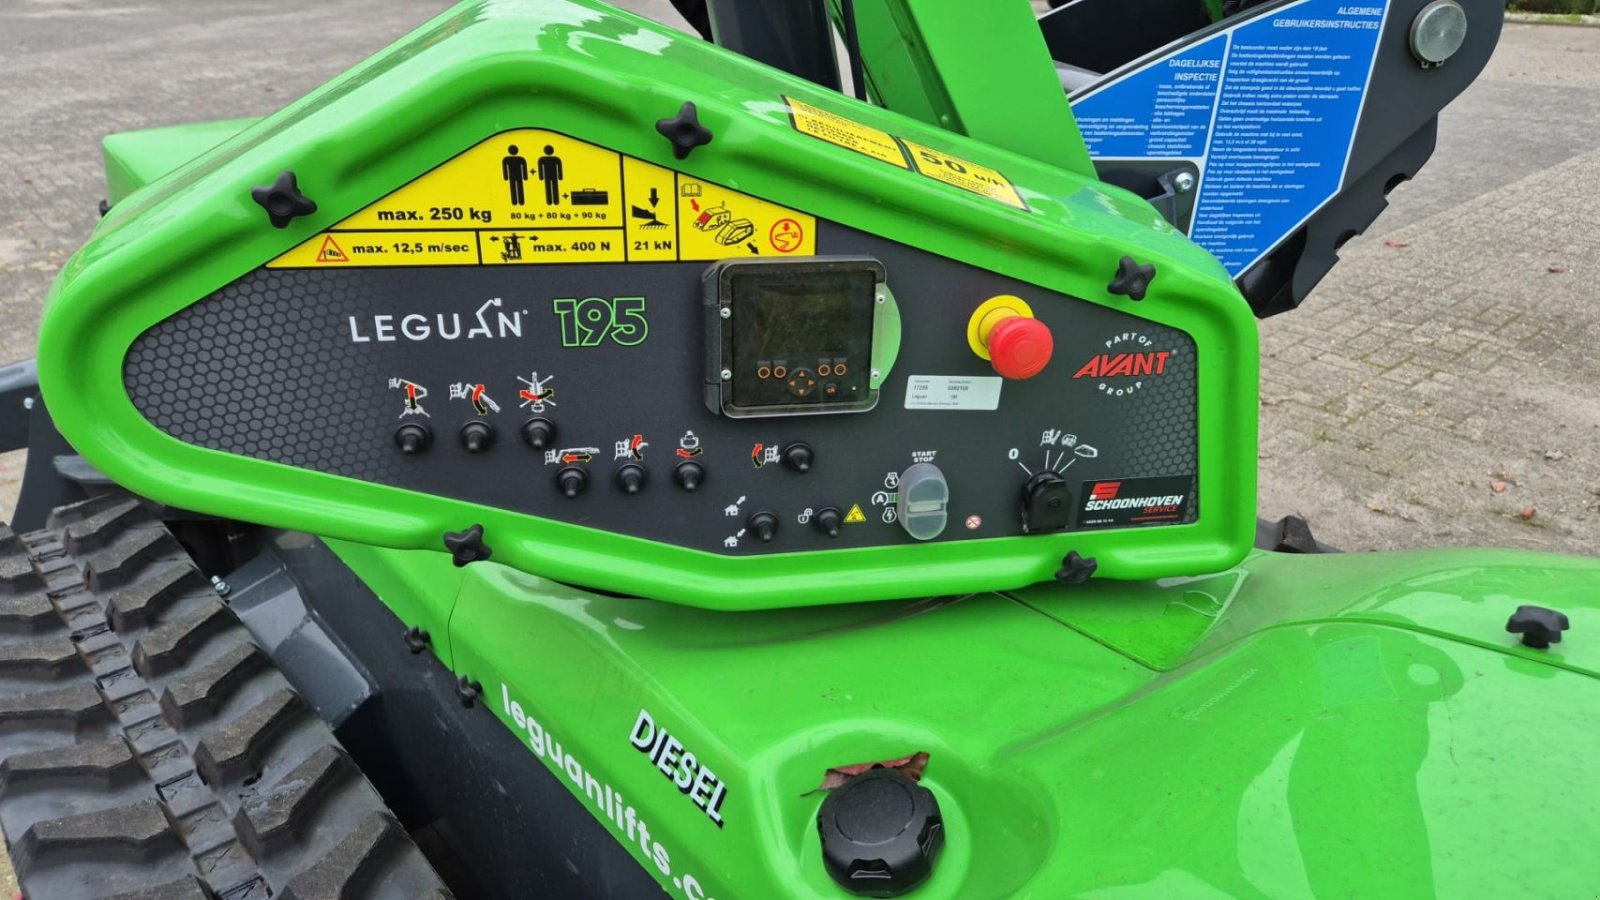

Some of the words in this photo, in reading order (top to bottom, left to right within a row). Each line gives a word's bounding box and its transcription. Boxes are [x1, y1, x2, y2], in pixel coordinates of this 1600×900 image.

[1337, 7, 1382, 16] ALGEMENE
[1273, 19, 1379, 29] GEBRUIKERSINSTRUCTIES
[1169, 60, 1220, 68] DAGELIJKSE
[1174, 73, 1218, 81] INSPECTIE
[920, 150, 967, 174] 50
[378, 209, 424, 222] max.
[429, 208, 464, 221] 250
[469, 207, 492, 223] kg
[510, 212, 520, 220] 80
[522, 211, 536, 221] kg
[546, 212, 557, 220] 80
[558, 211, 572, 221] kg
[582, 211, 593, 219] 90
[594, 211, 606, 221] kg
[352, 244, 389, 254] max.
[392, 243, 423, 255] 12,5
[428, 242, 470, 254] m/sec
[533, 243, 567, 252] max.
[570, 241, 596, 252] 400
[600, 241, 611, 251] N
[634, 242, 650, 250] 21
[654, 241, 672, 250] kN
[553, 297, 649, 347] 195
[1106, 332, 1137, 348] PART
[1138, 336, 1153, 347] OF
[1072, 352, 1170, 378] AVANT
[1099, 382, 1142, 396] GROUP
[1084, 495, 1184, 511] SCHOONHOVEN
[1143, 506, 1177, 514] SERVICE
[629, 708, 727, 829] DIESEL
